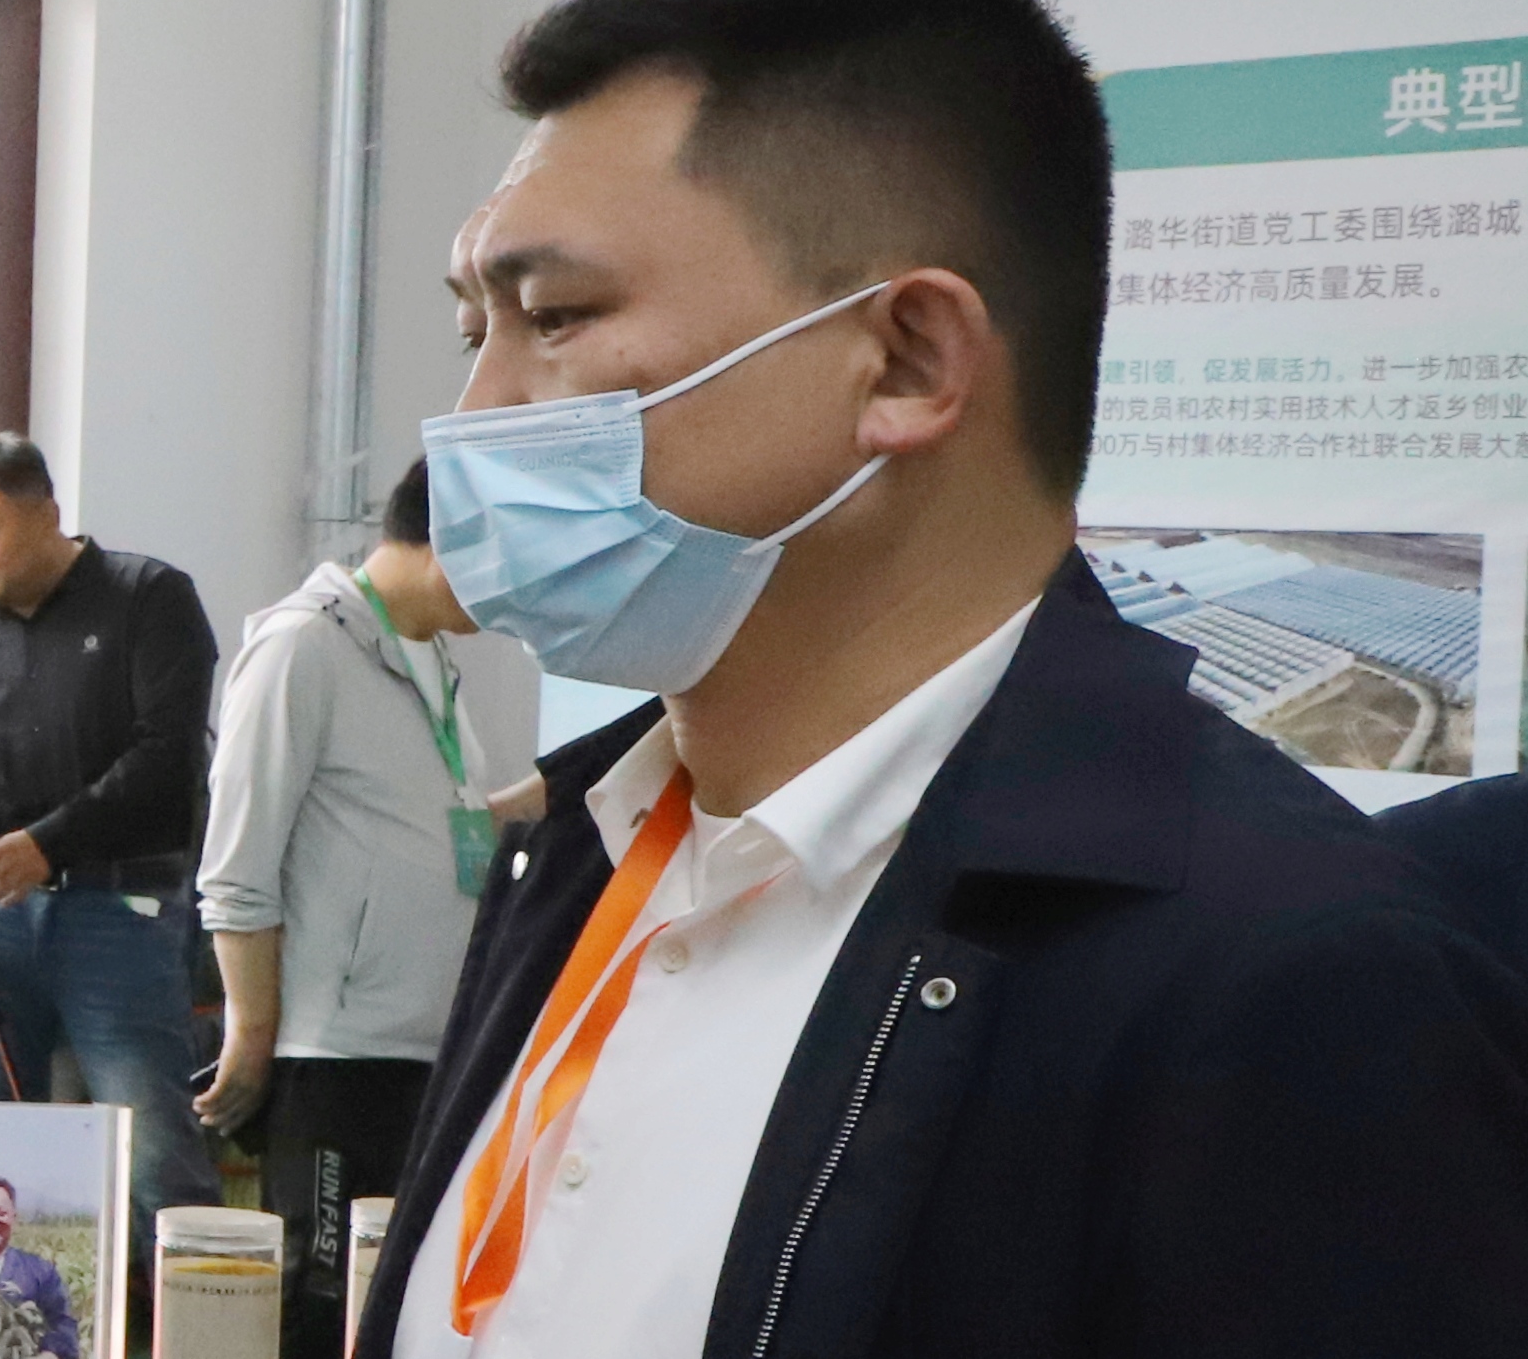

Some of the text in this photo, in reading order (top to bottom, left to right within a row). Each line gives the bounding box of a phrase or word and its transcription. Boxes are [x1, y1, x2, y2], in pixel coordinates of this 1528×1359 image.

[1382, 61, 1524, 138] 典型
[1123, 198, 1522, 251] 潞华街道党工委围绕潞城
[1110, 263, 1441, 306] 集体经济高质量发展。
[318, 1149, 340, 1269] RUN FAST
